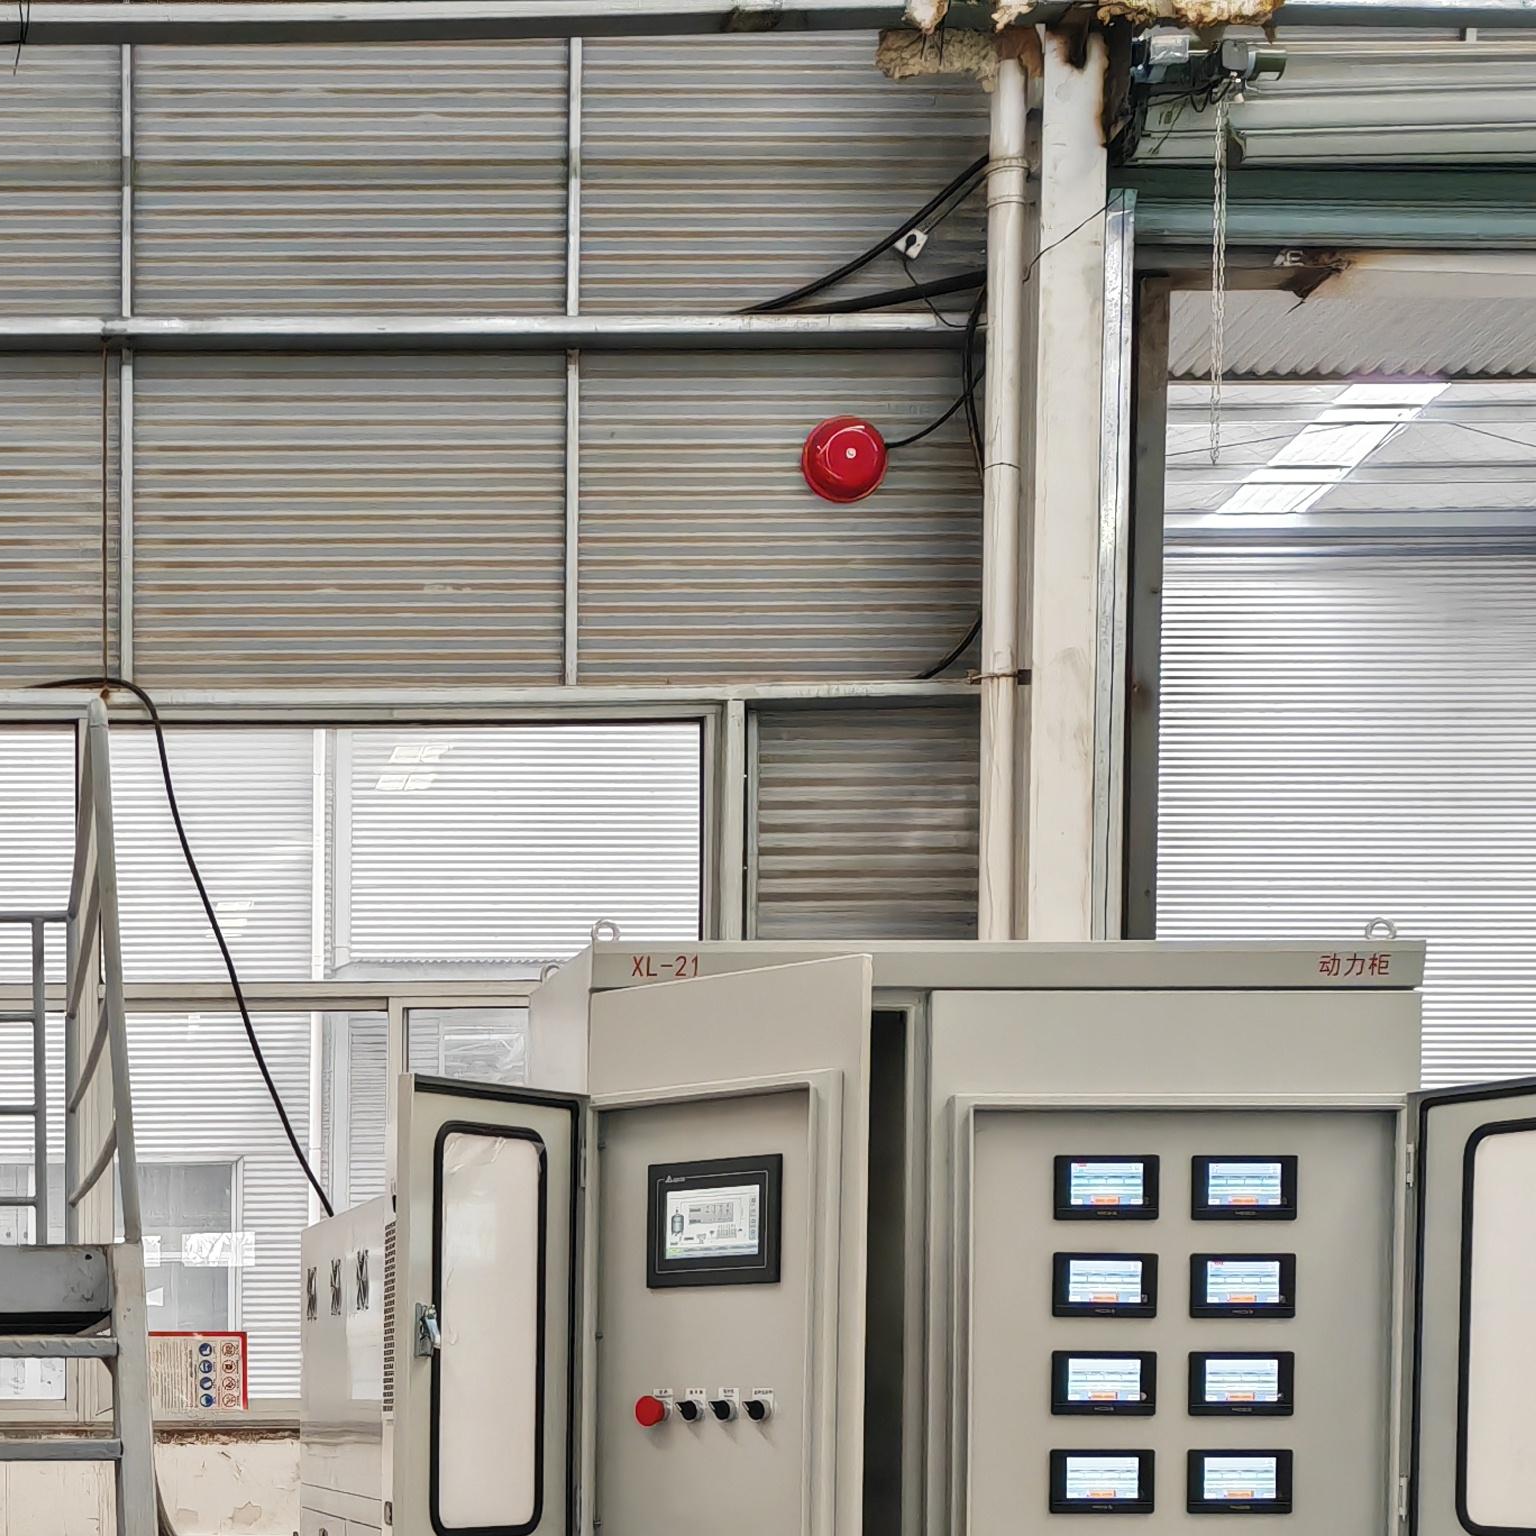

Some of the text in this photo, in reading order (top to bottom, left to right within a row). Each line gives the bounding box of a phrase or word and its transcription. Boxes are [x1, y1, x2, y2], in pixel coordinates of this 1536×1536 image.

[632, 955, 698, 977] XL-21
[1319, 953, 1391, 976] 动力柜
